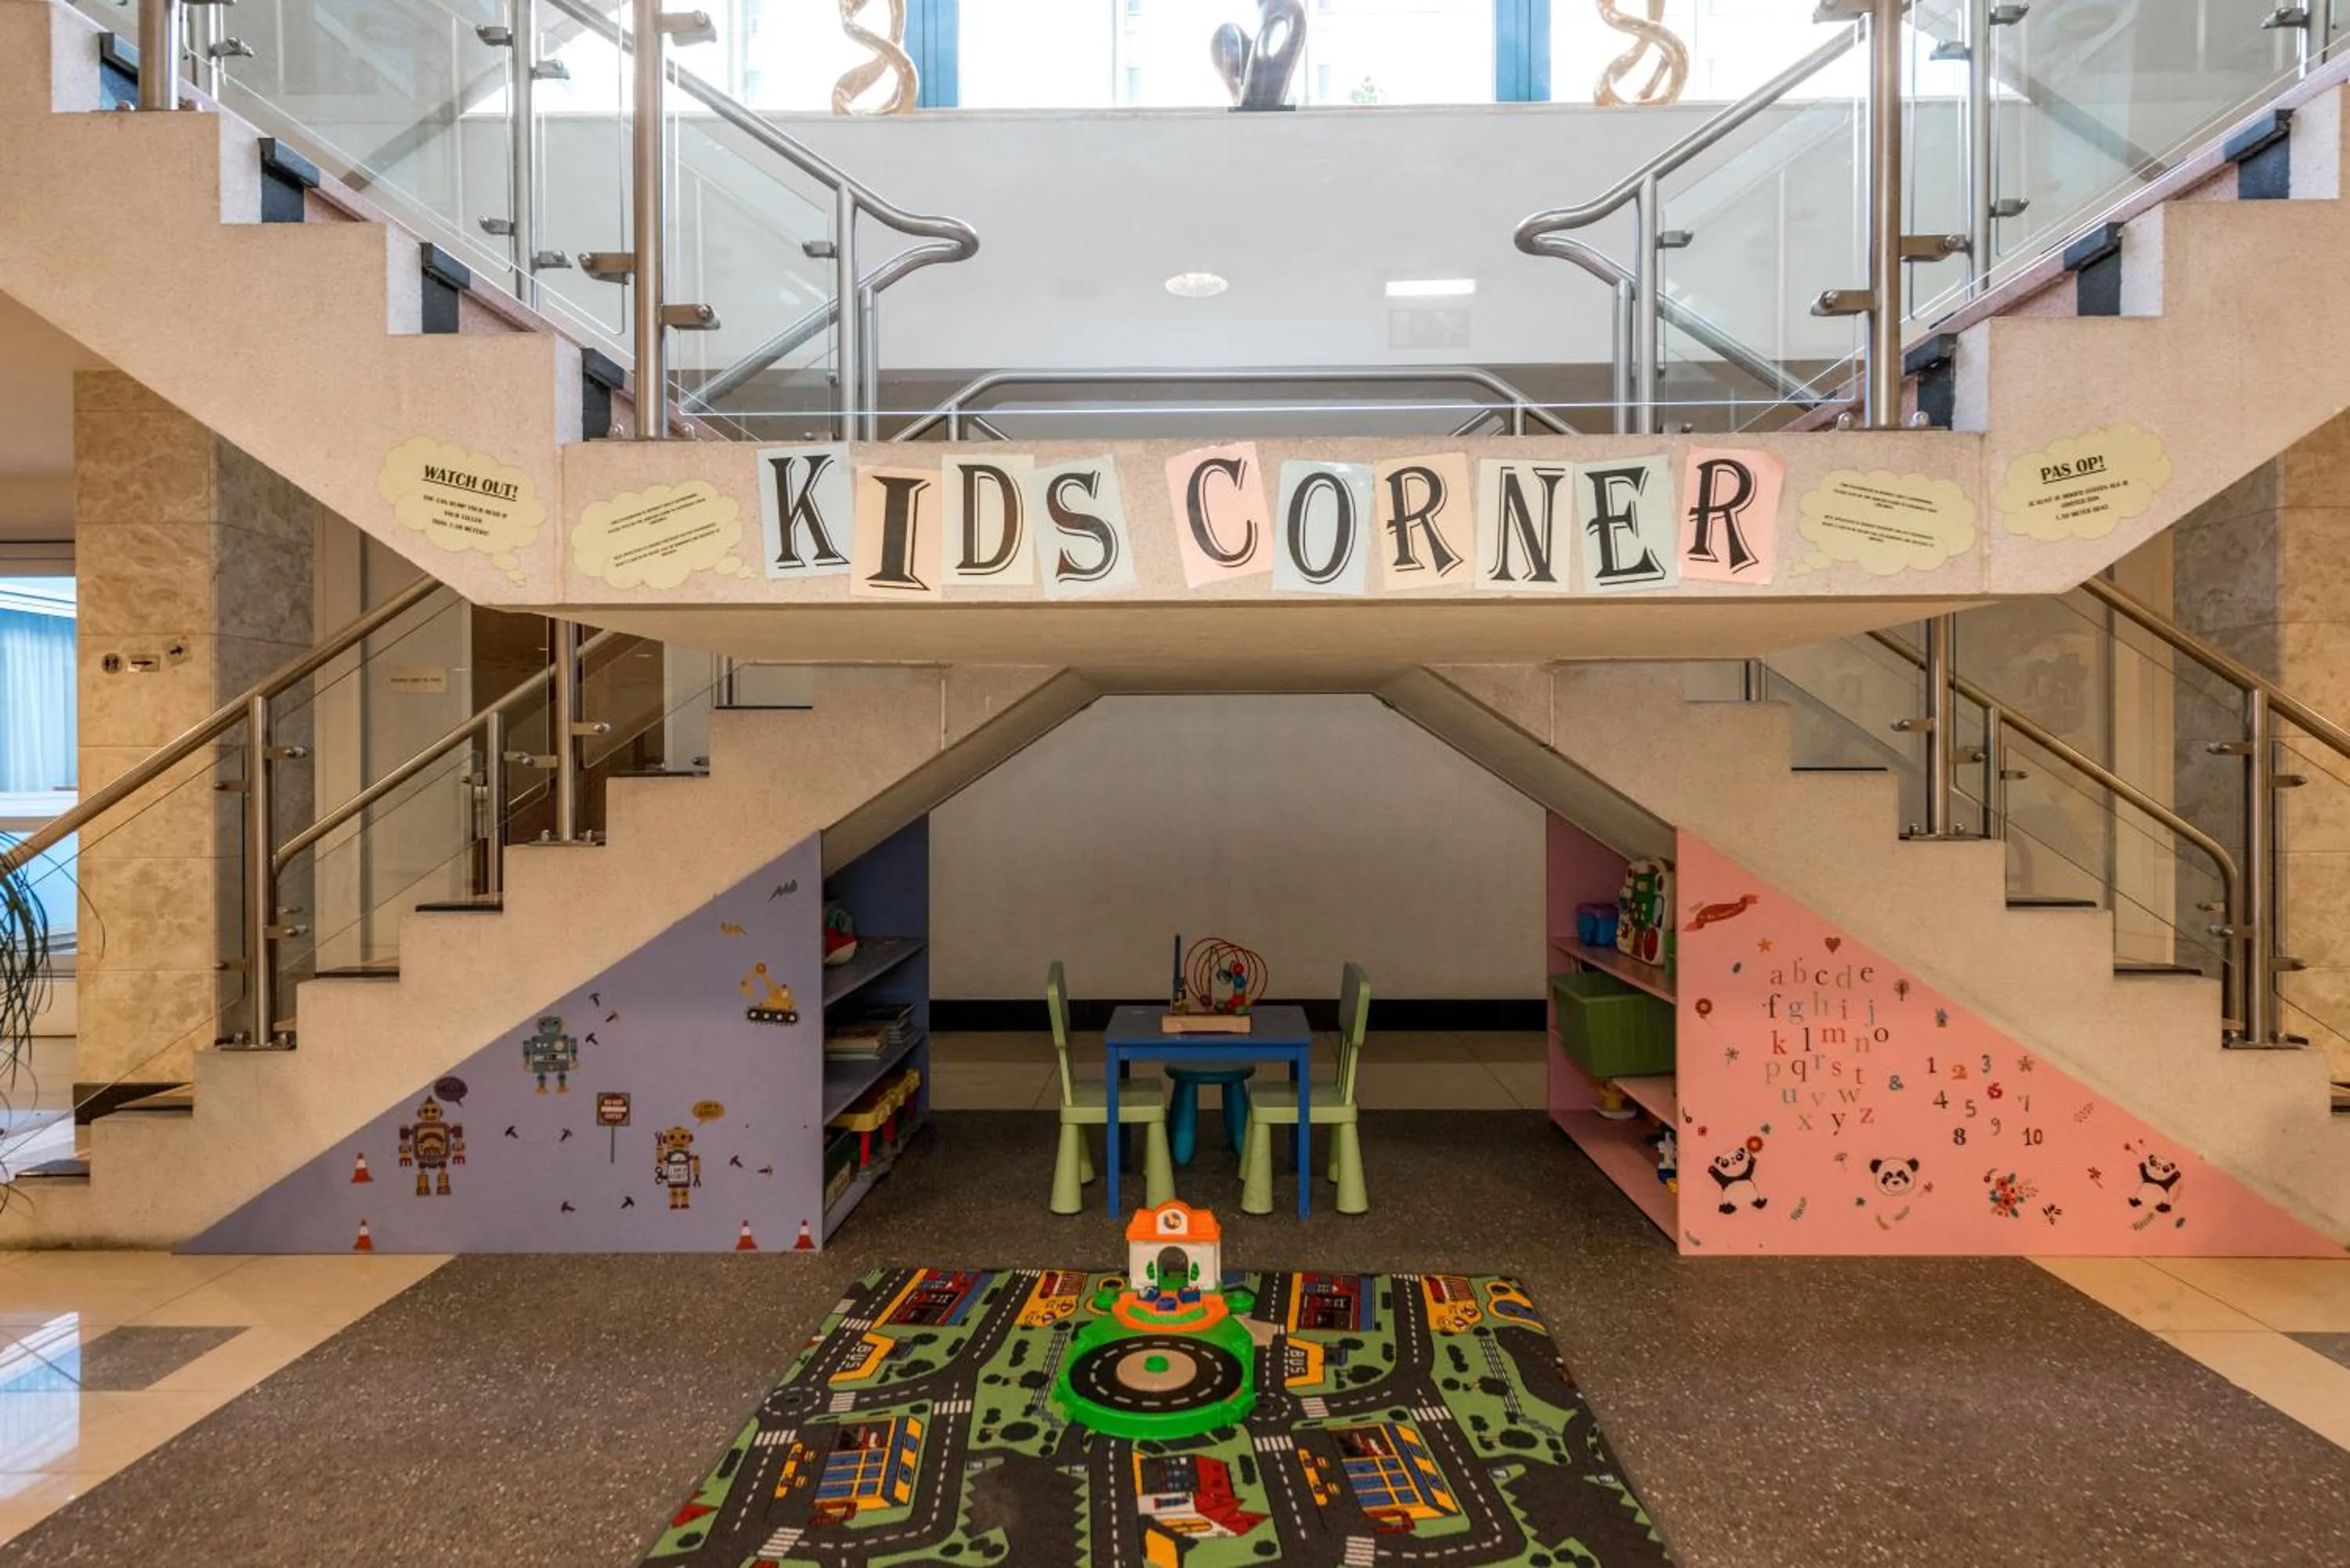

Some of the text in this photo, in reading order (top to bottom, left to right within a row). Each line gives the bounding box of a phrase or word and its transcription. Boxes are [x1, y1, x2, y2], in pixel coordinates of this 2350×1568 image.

[424, 464, 519, 500] WATCH OUT!
[2040, 454, 2106, 482] PAS OP!
[768, 453, 1759, 591] KIDS CORNER
[1289, 1349, 1306, 1374] BUS
